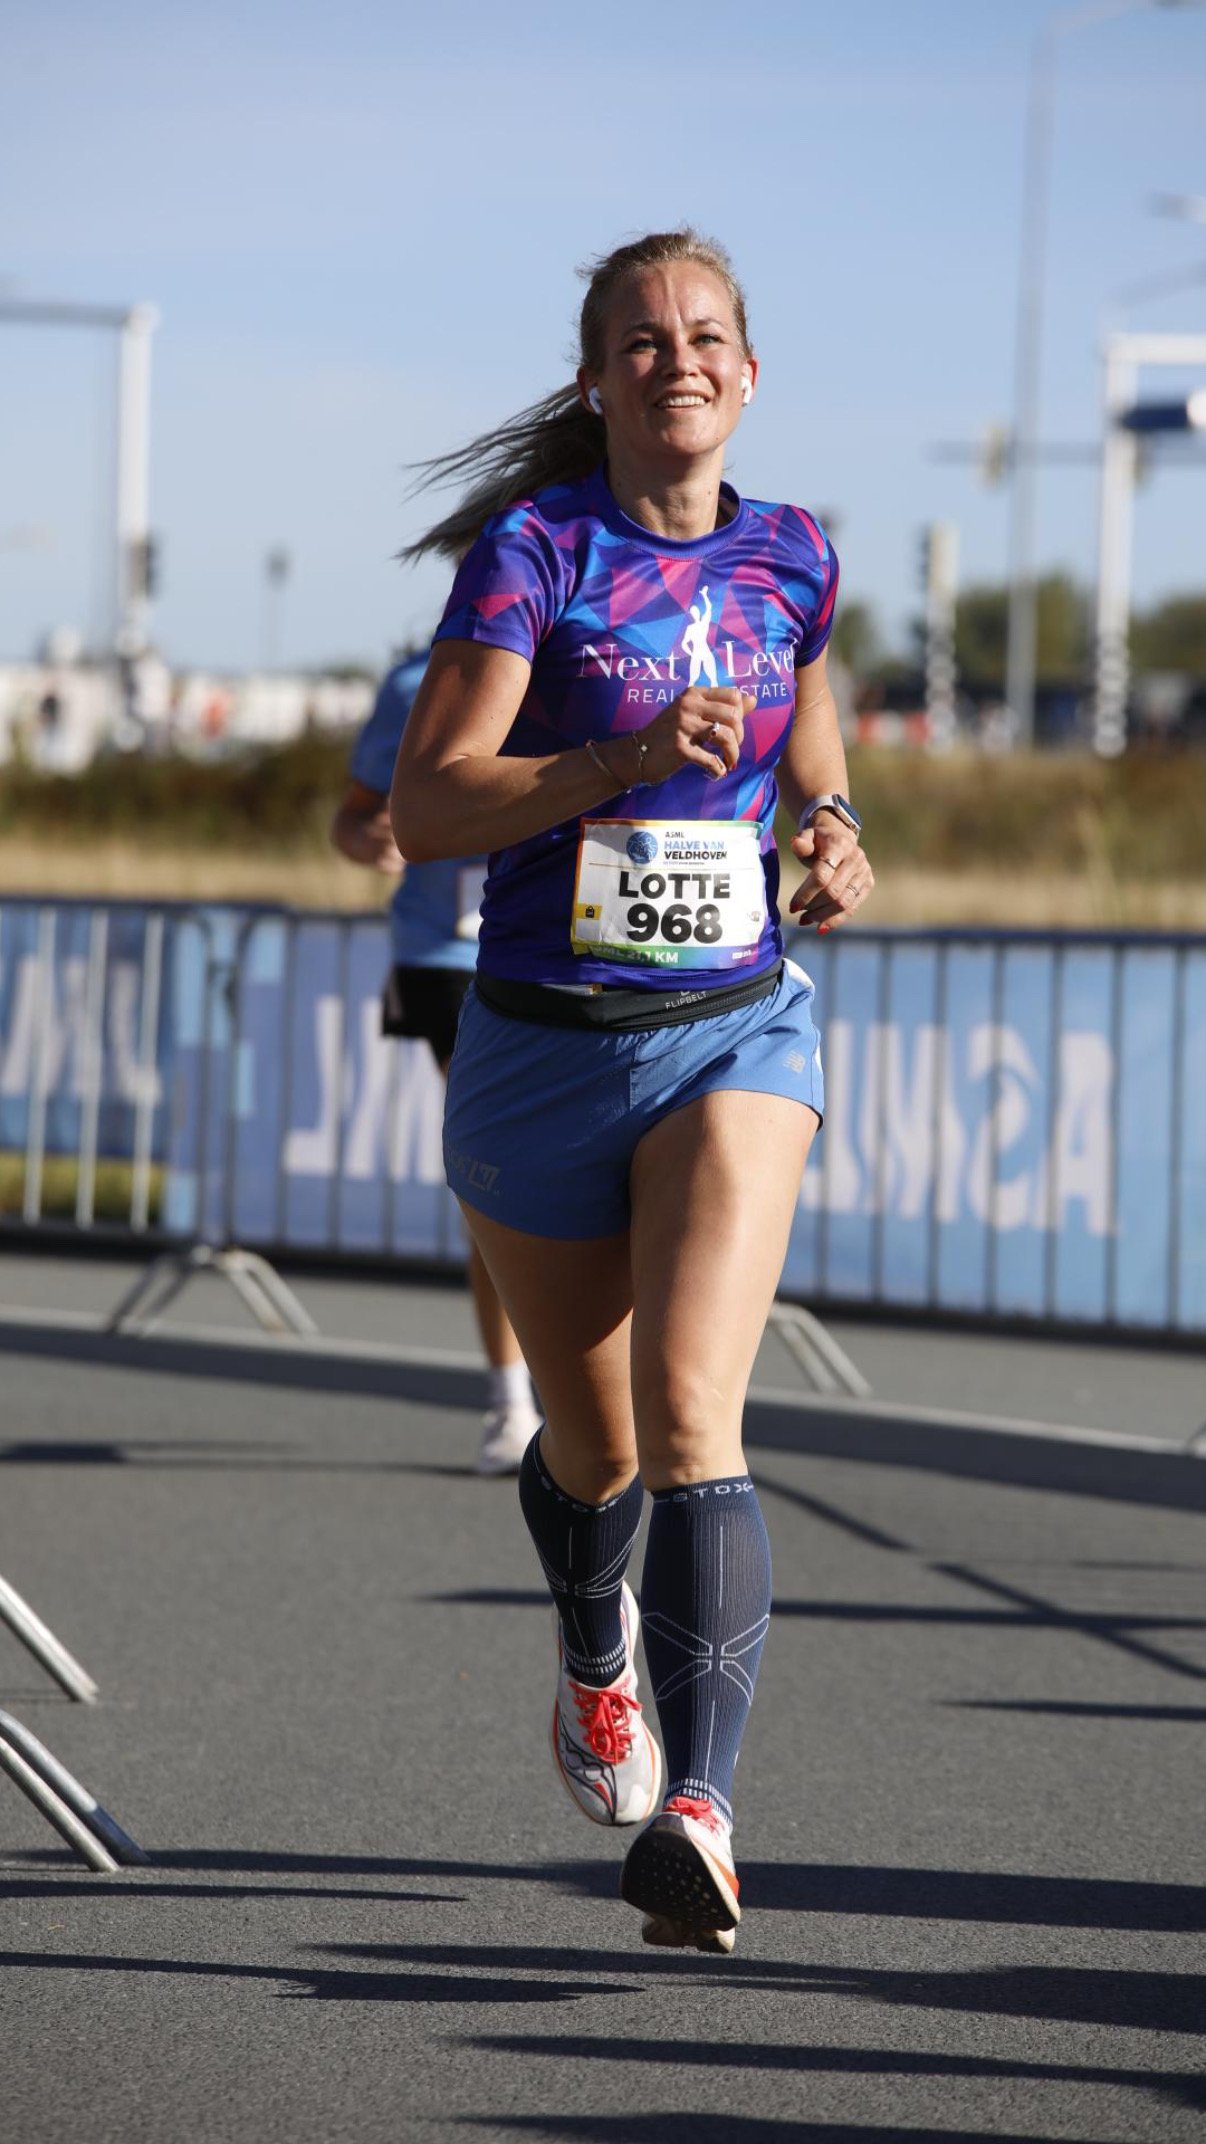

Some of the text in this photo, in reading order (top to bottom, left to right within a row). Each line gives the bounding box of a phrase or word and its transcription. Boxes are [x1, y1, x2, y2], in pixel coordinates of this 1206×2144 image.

[576, 643, 681, 681] Next
[732, 682, 787, 699] STATE
[665, 831, 685, 839] ASML
[664, 840, 724, 850] HALVE VAN
[664, 850, 728, 860] VELDHOVEN
[618, 870, 731, 900] LOTTE
[626, 903, 723, 944] 968
[655, 951, 679, 963] KM
[665, 990, 707, 1010] FLIPBELT
